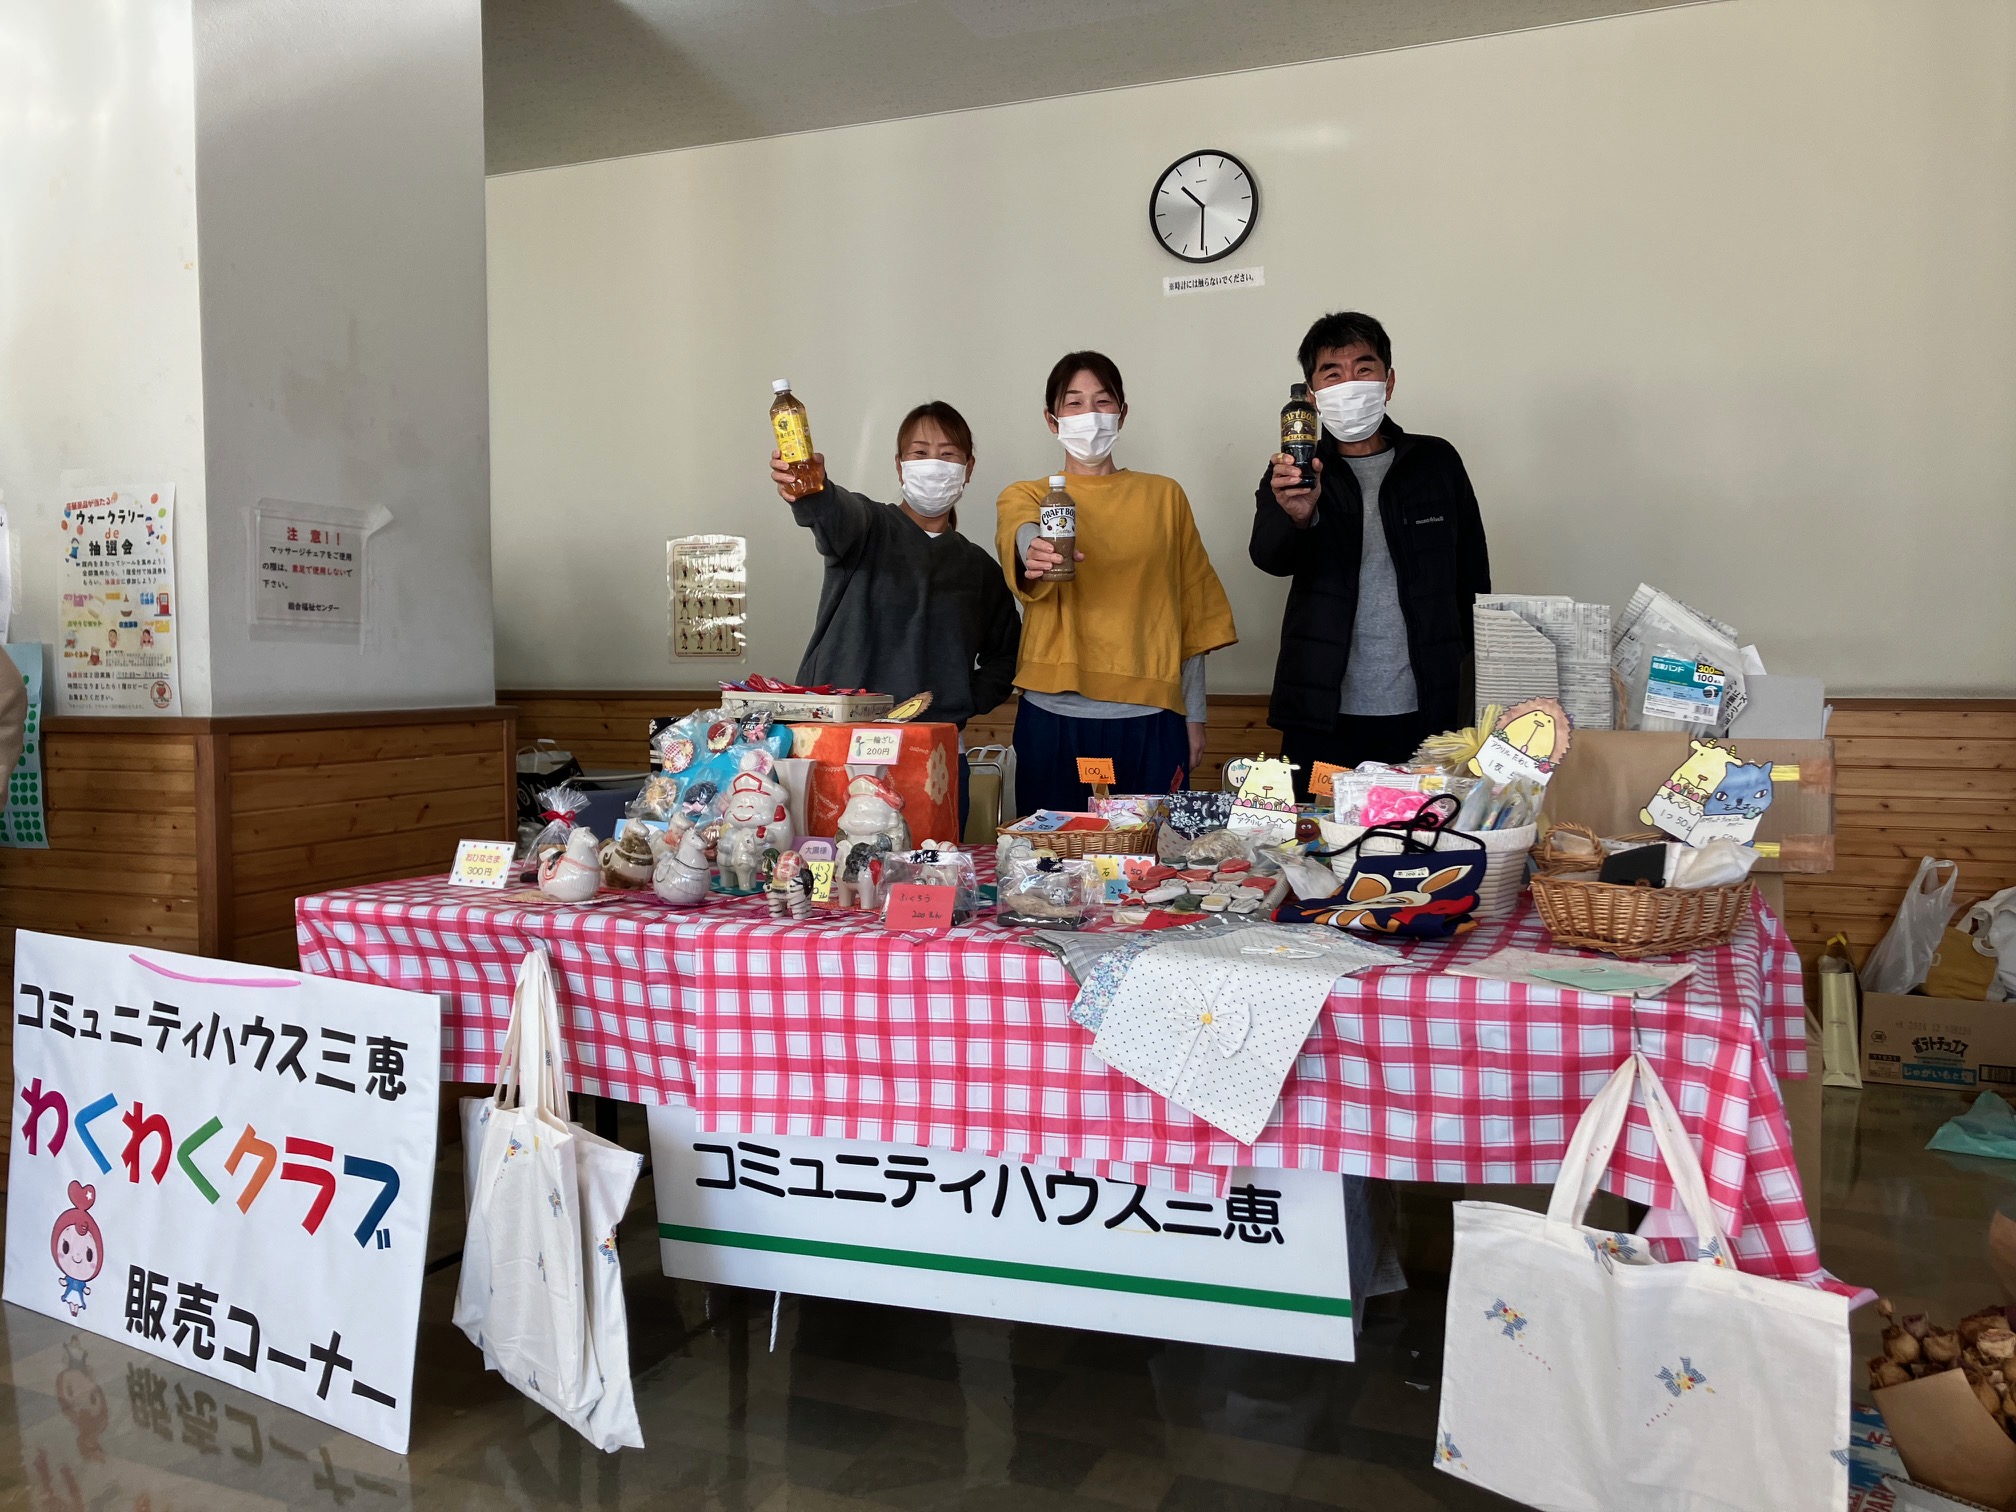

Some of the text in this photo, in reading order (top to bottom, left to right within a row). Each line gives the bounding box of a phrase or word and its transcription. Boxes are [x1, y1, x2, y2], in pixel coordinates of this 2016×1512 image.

[1169, 273, 1254, 290] ※時計には触らないでください。
[76, 510, 144, 525] ウォークラリー
[1042, 508, 1064, 525] CRAFT
[104, 527, 119, 539] de
[89, 539, 133, 556] 抽選会
[270, 546, 352, 561] マッサージチェアをご使用
[262, 562, 353, 577] の際は、素足で使用しないで
[262, 580, 288, 589] 下さい。
[288, 602, 339, 611] 総合福祉センター
[866, 736, 895, 744] 一輪ざし
[866, 747, 890, 756] 200円
[465, 853, 501, 864] おひなさま
[467, 866, 493, 877] 300円
[900, 893, 931, 903] ふくろう
[17, 982, 409, 1102] コミュニティハウス三恵
[1911, 1036, 1969, 1058] ポテトチップス
[20, 1076, 400, 1251] わくわくクラブ
[692, 1141, 1284, 1245] コミュニティハウス三恵
[124, 1264, 397, 1409] 販売コーナー
